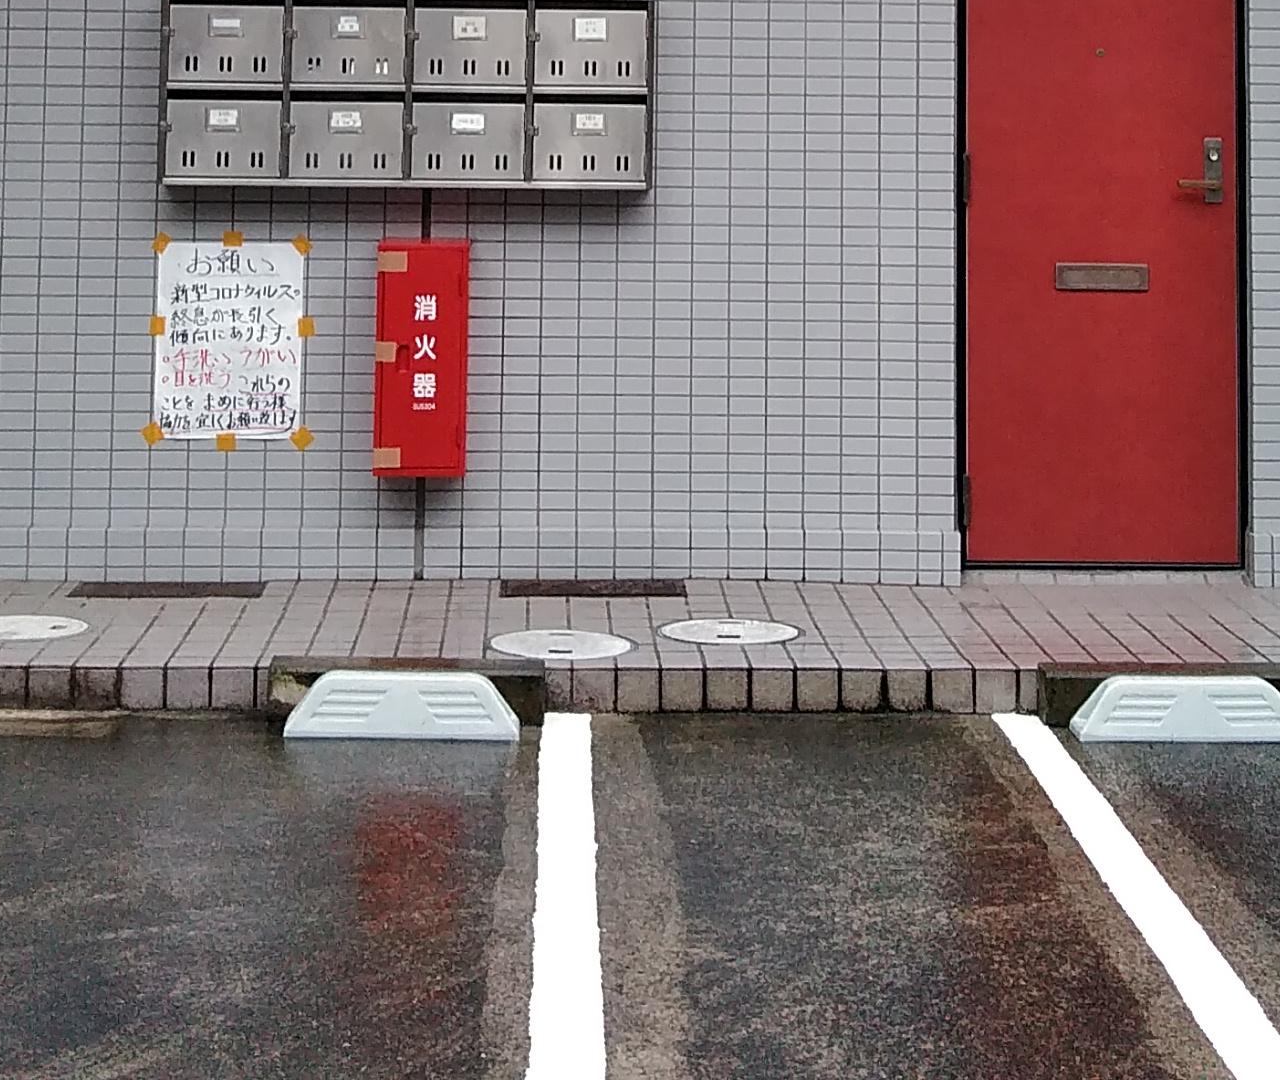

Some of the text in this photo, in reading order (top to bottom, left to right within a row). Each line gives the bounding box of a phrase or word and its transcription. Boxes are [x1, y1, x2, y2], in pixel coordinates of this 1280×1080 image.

[186, 248, 275, 274] お願い
[413, 294, 437, 398] 消火器
